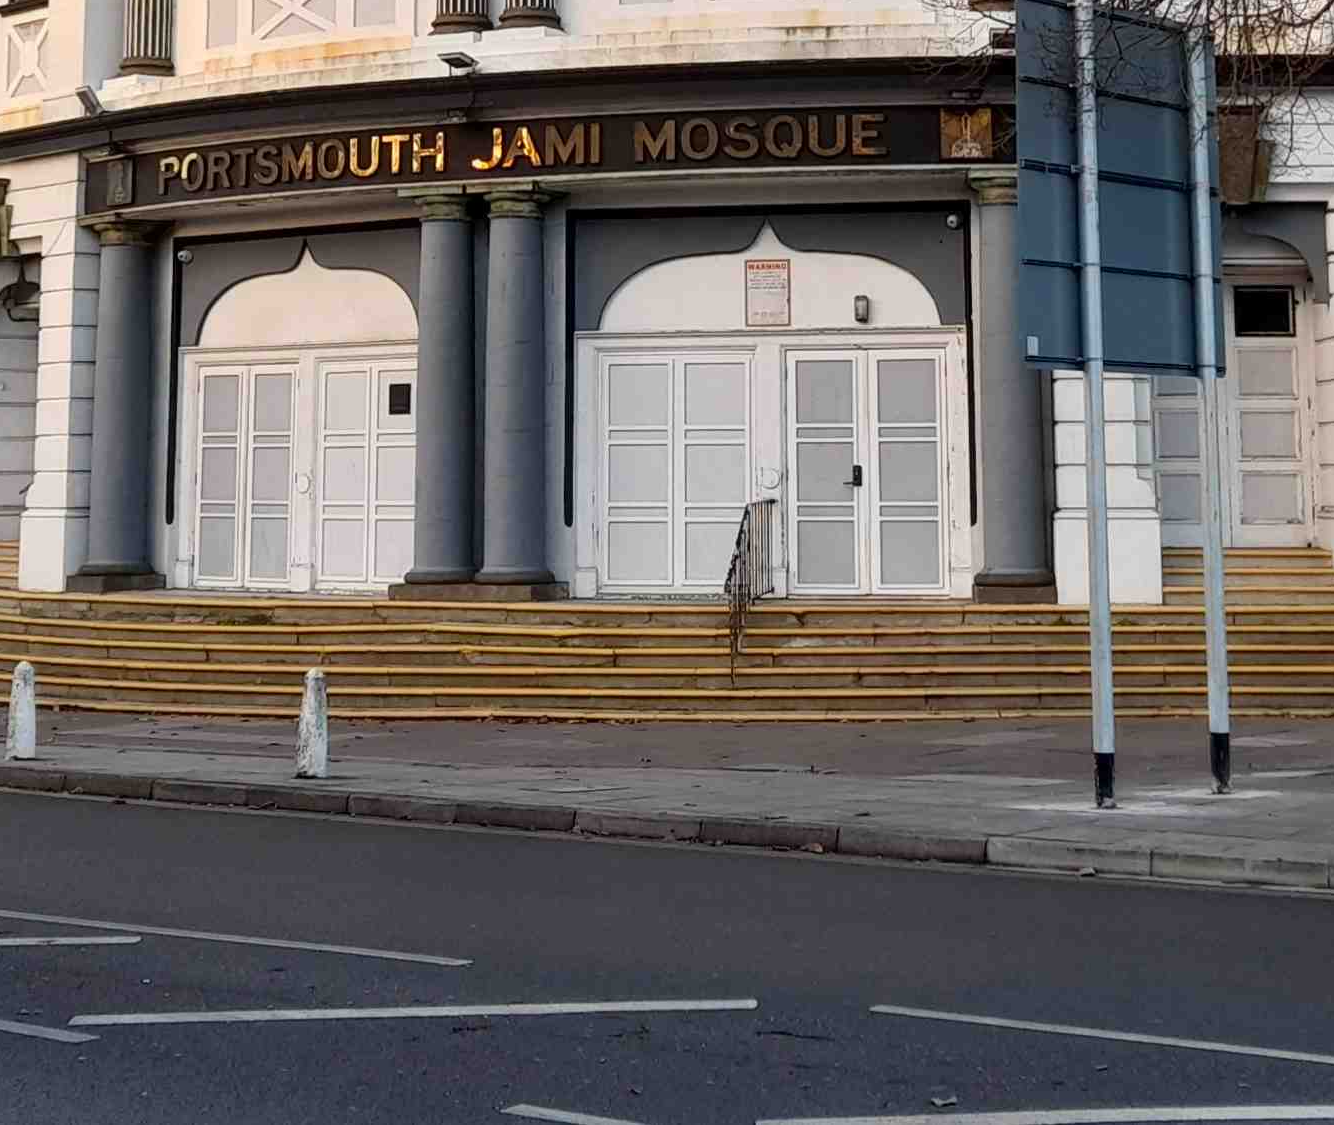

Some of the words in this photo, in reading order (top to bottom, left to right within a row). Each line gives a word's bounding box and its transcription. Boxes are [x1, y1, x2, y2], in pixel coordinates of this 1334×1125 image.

[156, 131, 445, 196] PORTSMOUTH
[470, 122, 603, 171] JAMI
[633, 113, 890, 164] MOSQUE
[747, 263, 787, 271] WARNING
